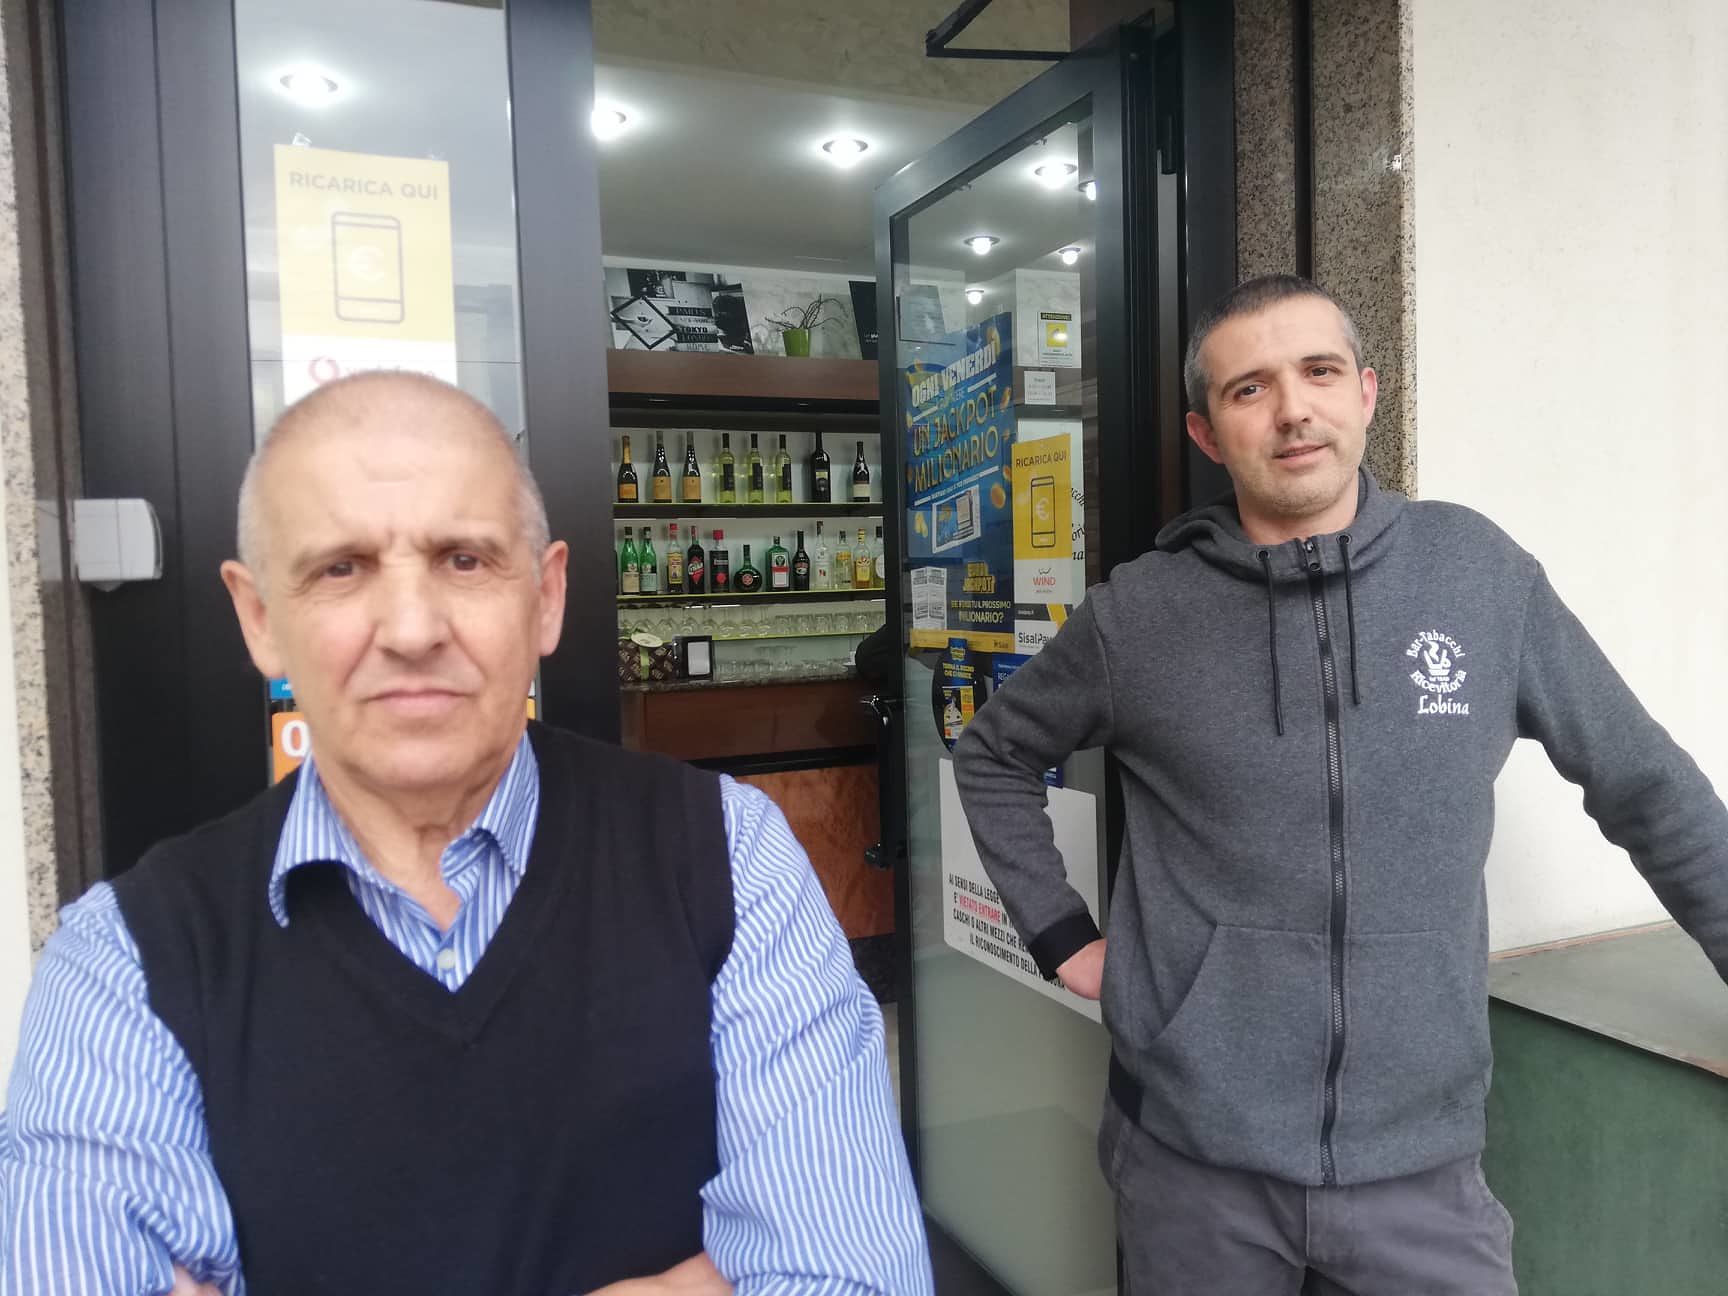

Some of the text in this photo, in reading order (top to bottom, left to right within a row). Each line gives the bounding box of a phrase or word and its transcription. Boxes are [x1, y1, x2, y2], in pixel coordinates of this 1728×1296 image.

[289, 171, 439, 200] RICARICA QUI
[680, 326, 708, 334] TOKYO
[912, 374, 939, 408] OGNI
[914, 421, 930, 457] UN
[934, 385, 997, 448] JACKPOT
[915, 426, 999, 494] MILIONARIO
[1015, 451, 1067, 468] RICARICA QUI
[1032, 576, 1057, 586] WIND
[1406, 629, 1466, 659] Bar-Tabacchi
[1417, 694, 1470, 714] Lobina
[954, 875, 968, 891] SENSI
[968, 880, 983, 897] DELLA
[984, 887, 1000, 905] LEGGE
[959, 894, 978, 910] VIETATO
[978, 902, 1001, 922] ENTRARE
[953, 908, 970, 925] CASCHI
[975, 919, 989, 935] ALTRI
[989, 924, 1005, 943] MEZZI
[1006, 931, 1017, 949] CHE
[970, 932, 975, 945] IL
[975, 934, 1020, 968] RICONOSCIMENTO
[1020, 958, 1038, 977] DELLA
